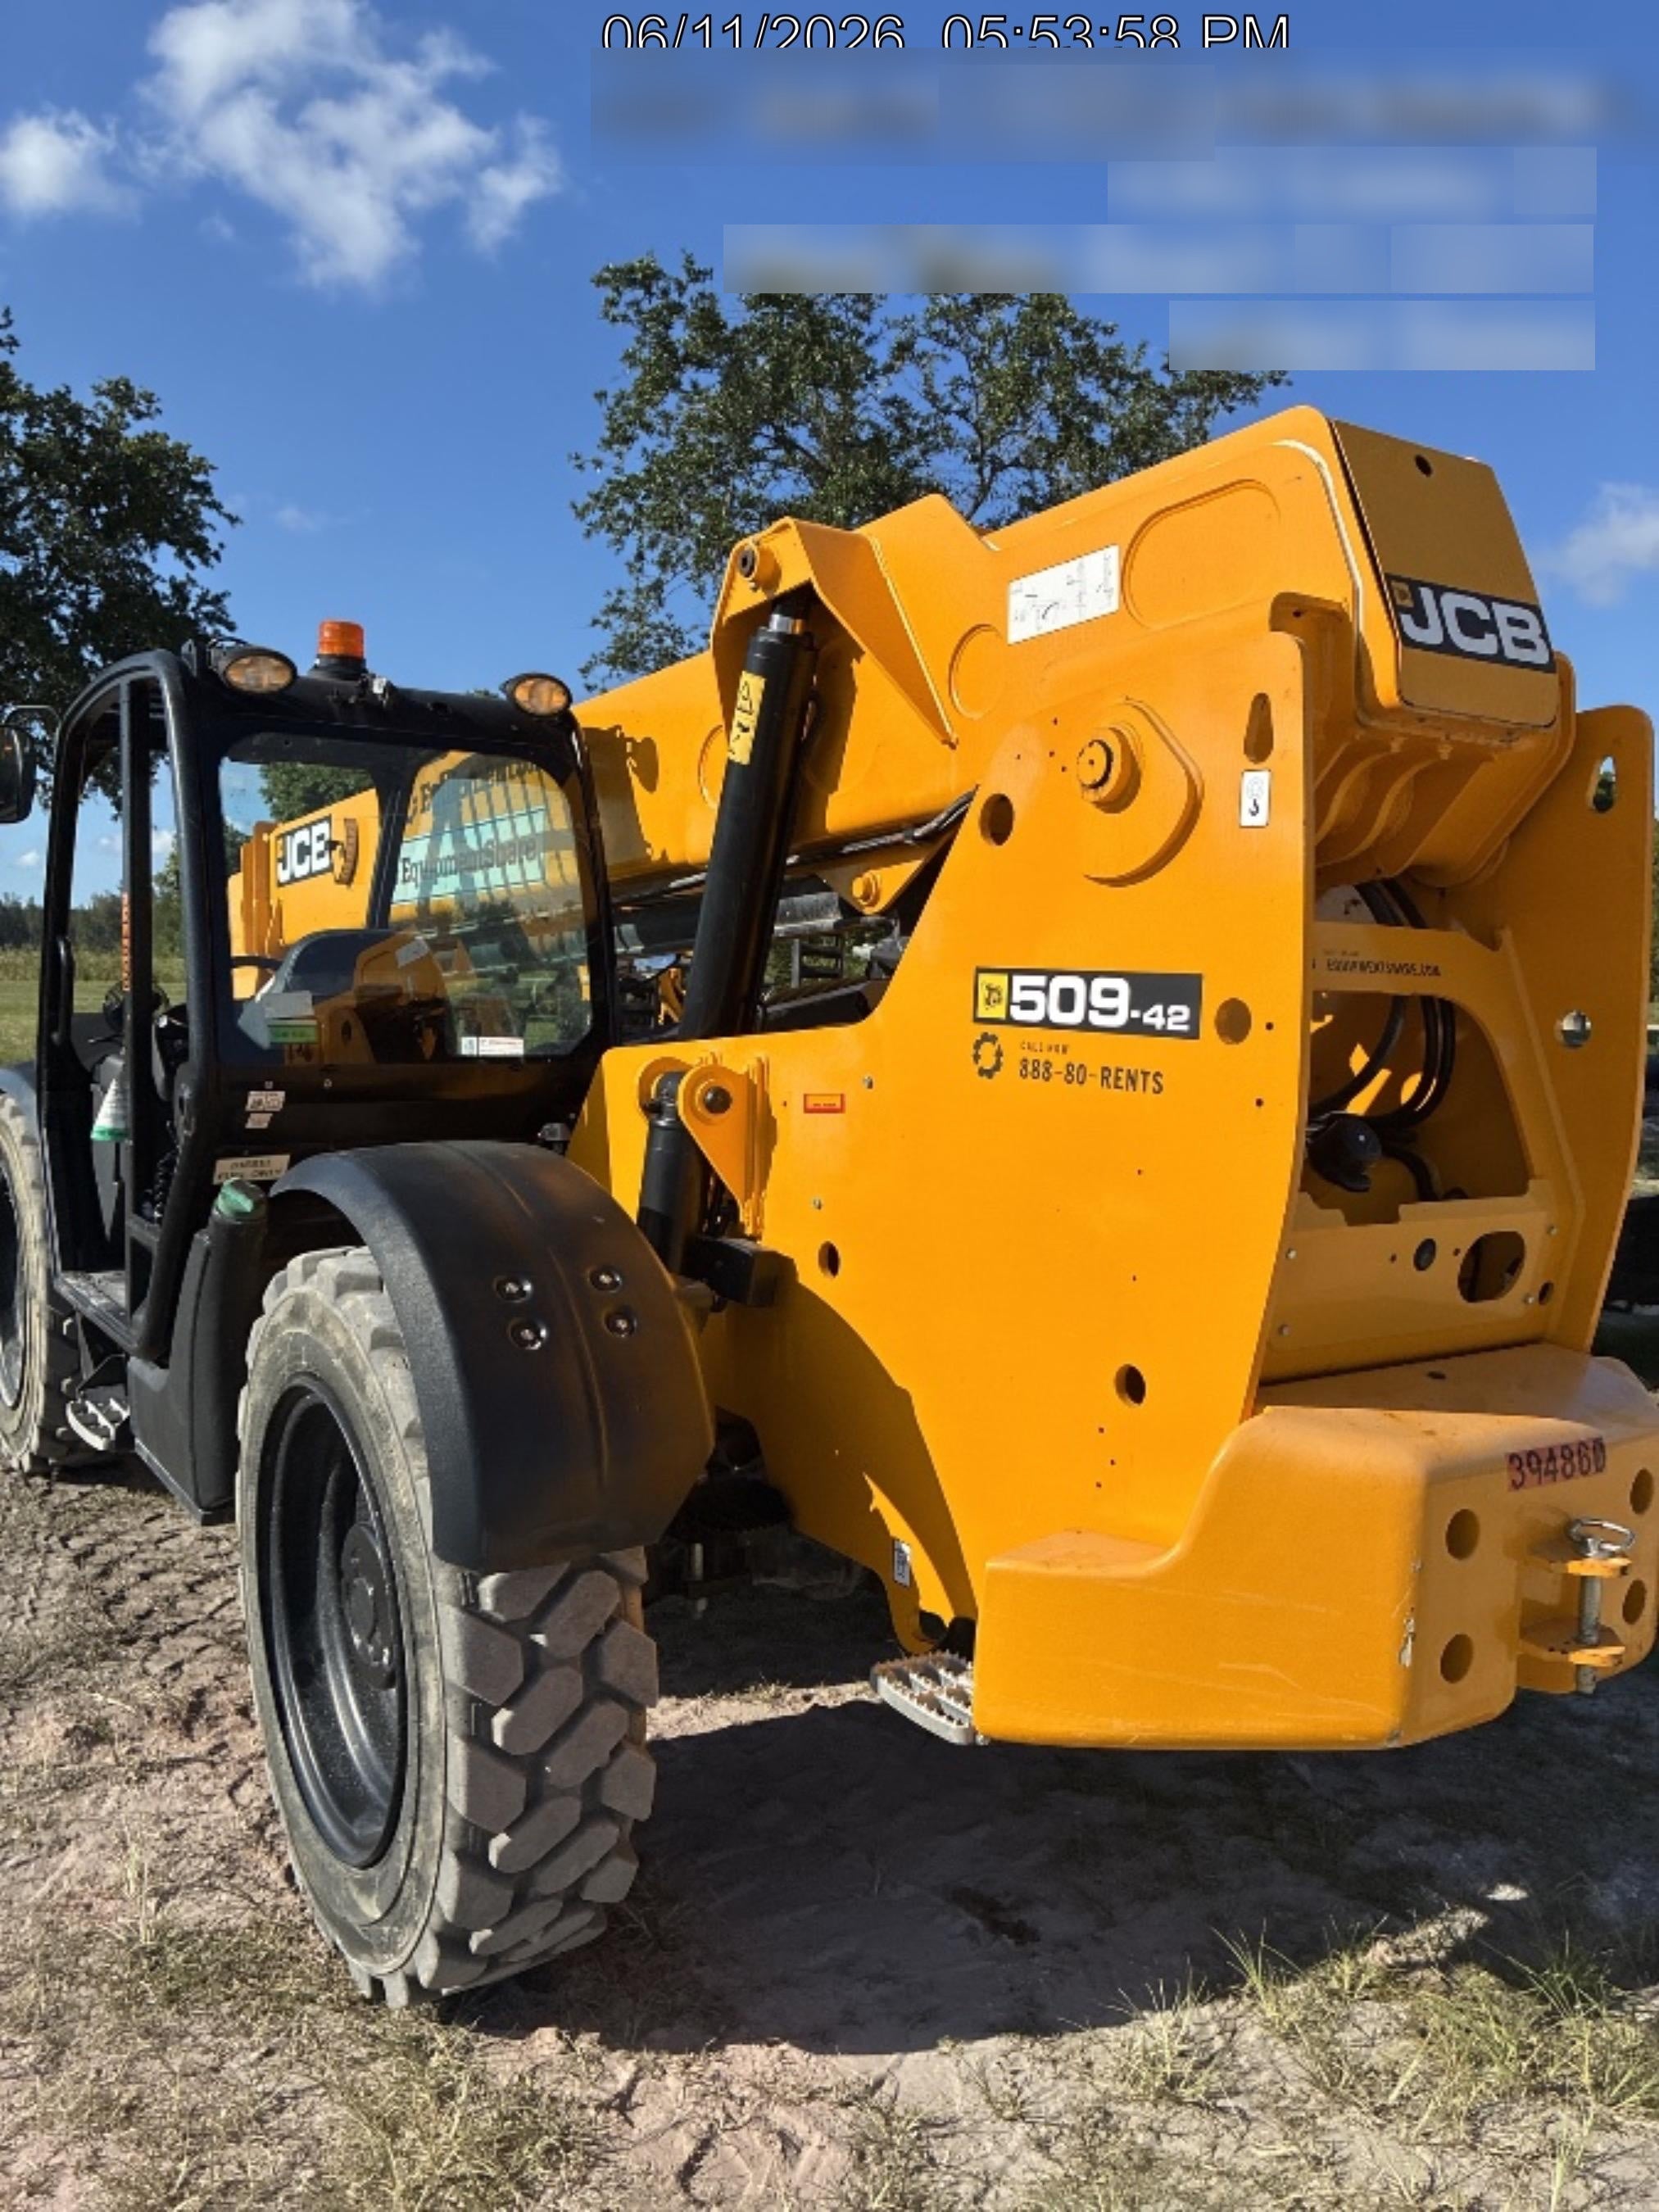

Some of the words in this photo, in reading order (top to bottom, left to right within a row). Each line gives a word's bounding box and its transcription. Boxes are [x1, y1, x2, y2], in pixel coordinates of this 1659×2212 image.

[1400, 587, 1549, 664] JCB
[276, 820, 330, 883] JCB
[1009, 974, 1190, 1031] 509-42
[1019, 1058, 1164, 1095] 888-80-RENTS
[1509, 1435, 1606, 1490] 394860
